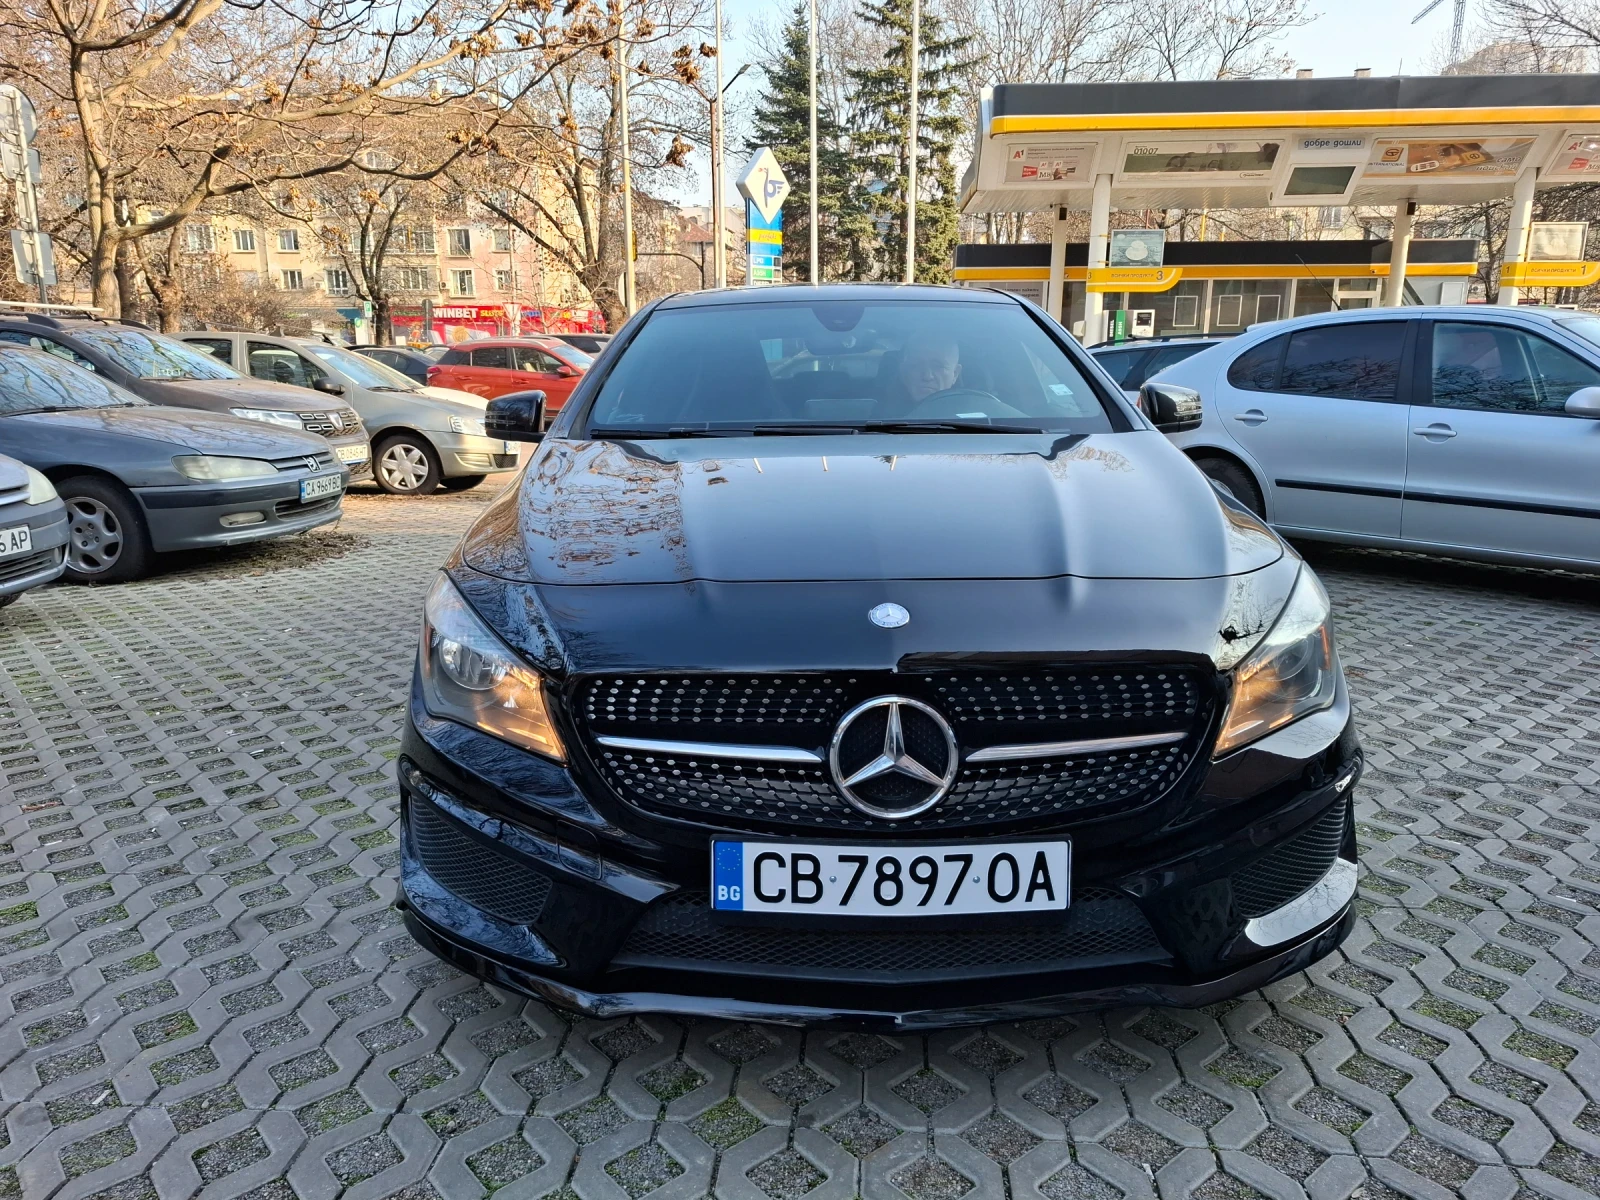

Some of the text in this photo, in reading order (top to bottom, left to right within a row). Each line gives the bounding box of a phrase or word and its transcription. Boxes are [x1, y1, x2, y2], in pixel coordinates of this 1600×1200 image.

[1304, 138, 1362, 148] добре дошли
[1156, 270, 1164, 281] 3
[1581, 264, 1587, 275] 1
[433, 307, 479, 318] WINBET
[306, 481, 315, 496] CA
[316, 477, 332, 494] 9669
[11, 530, 27, 550] AP
[753, 851, 824, 904] CB
[837, 854, 974, 907] 7897
[717, 885, 741, 902] BG
